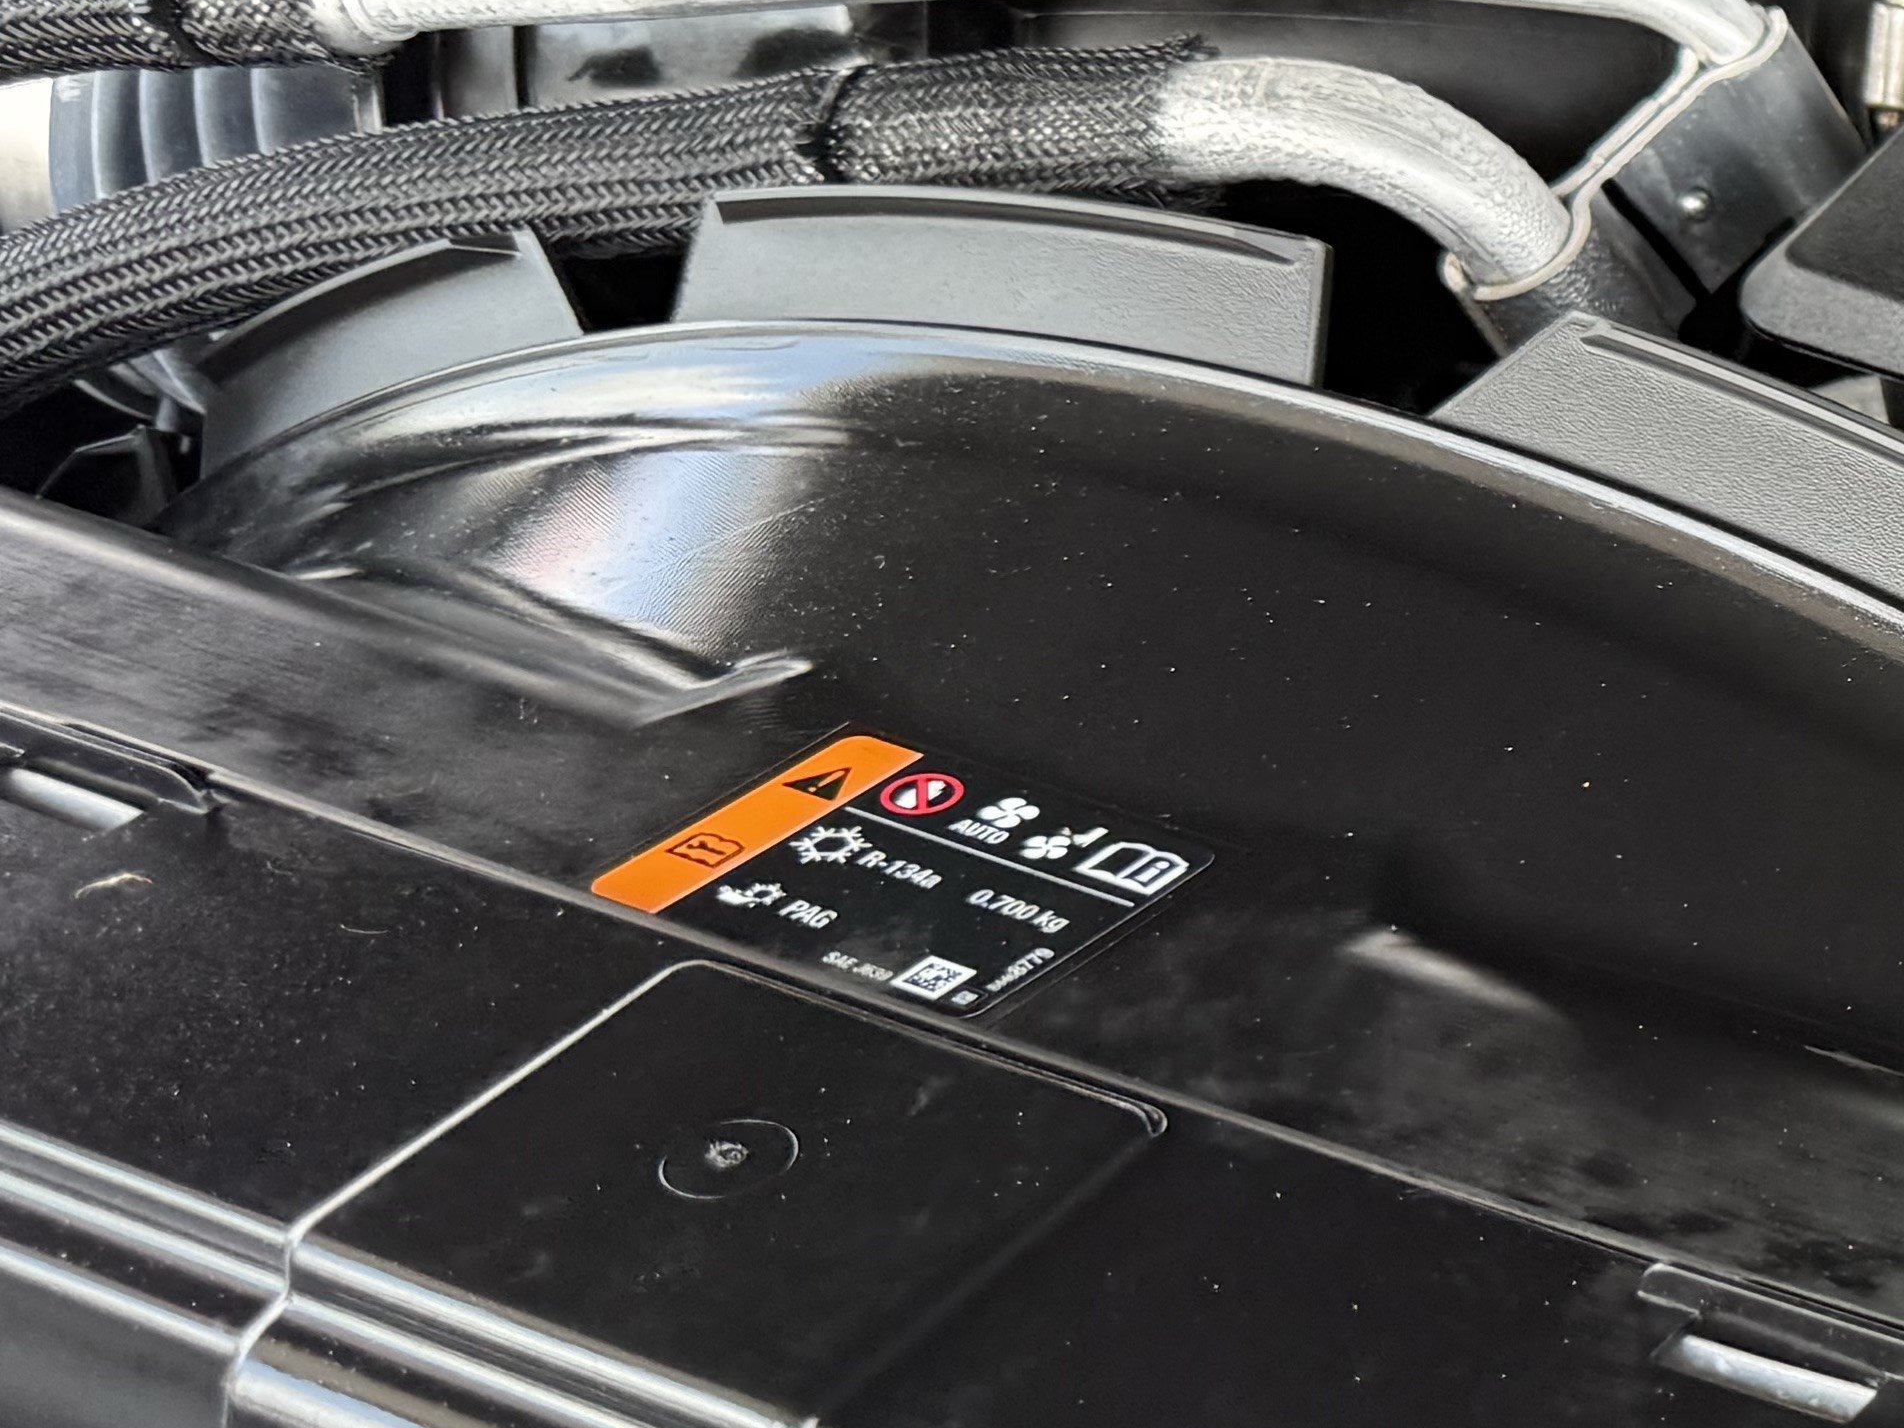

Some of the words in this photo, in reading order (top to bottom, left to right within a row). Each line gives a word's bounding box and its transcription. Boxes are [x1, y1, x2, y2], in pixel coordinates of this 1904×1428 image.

[947, 818, 1010, 844] AUTO
[856, 849, 943, 890] R-134a
[965, 888, 1041, 921] 0.700
[1034, 909, 1071, 934] kg
[777, 899, 838, 929] PAG
